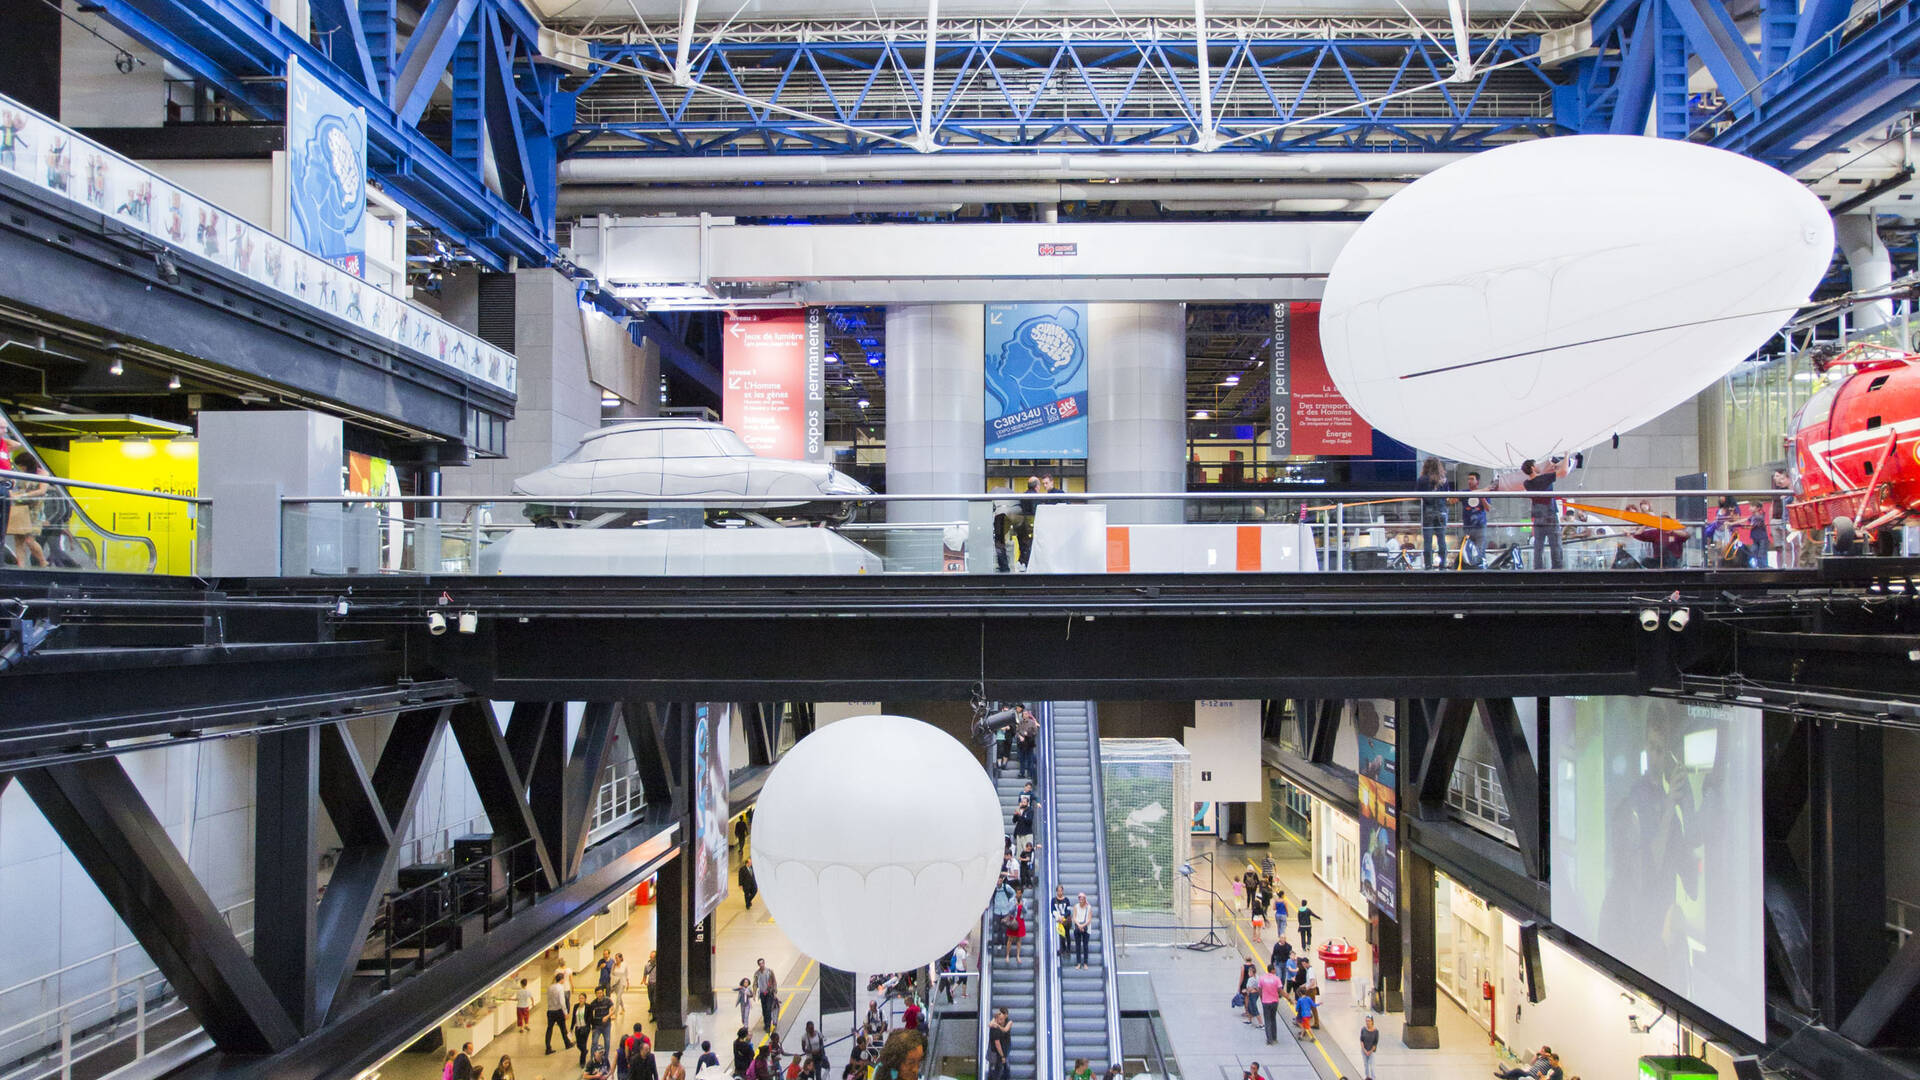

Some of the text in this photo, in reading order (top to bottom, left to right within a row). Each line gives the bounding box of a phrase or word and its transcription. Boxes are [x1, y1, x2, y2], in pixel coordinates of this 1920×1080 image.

[763, 332, 773, 340] de
[808, 308, 823, 454] expos permanentes
[1275, 302, 1289, 448] expos permanentes
[744, 381, 781, 390] L'Homme
[993, 407, 1041, 429] C3RV34U
[1043, 404, 1058, 416] 16
